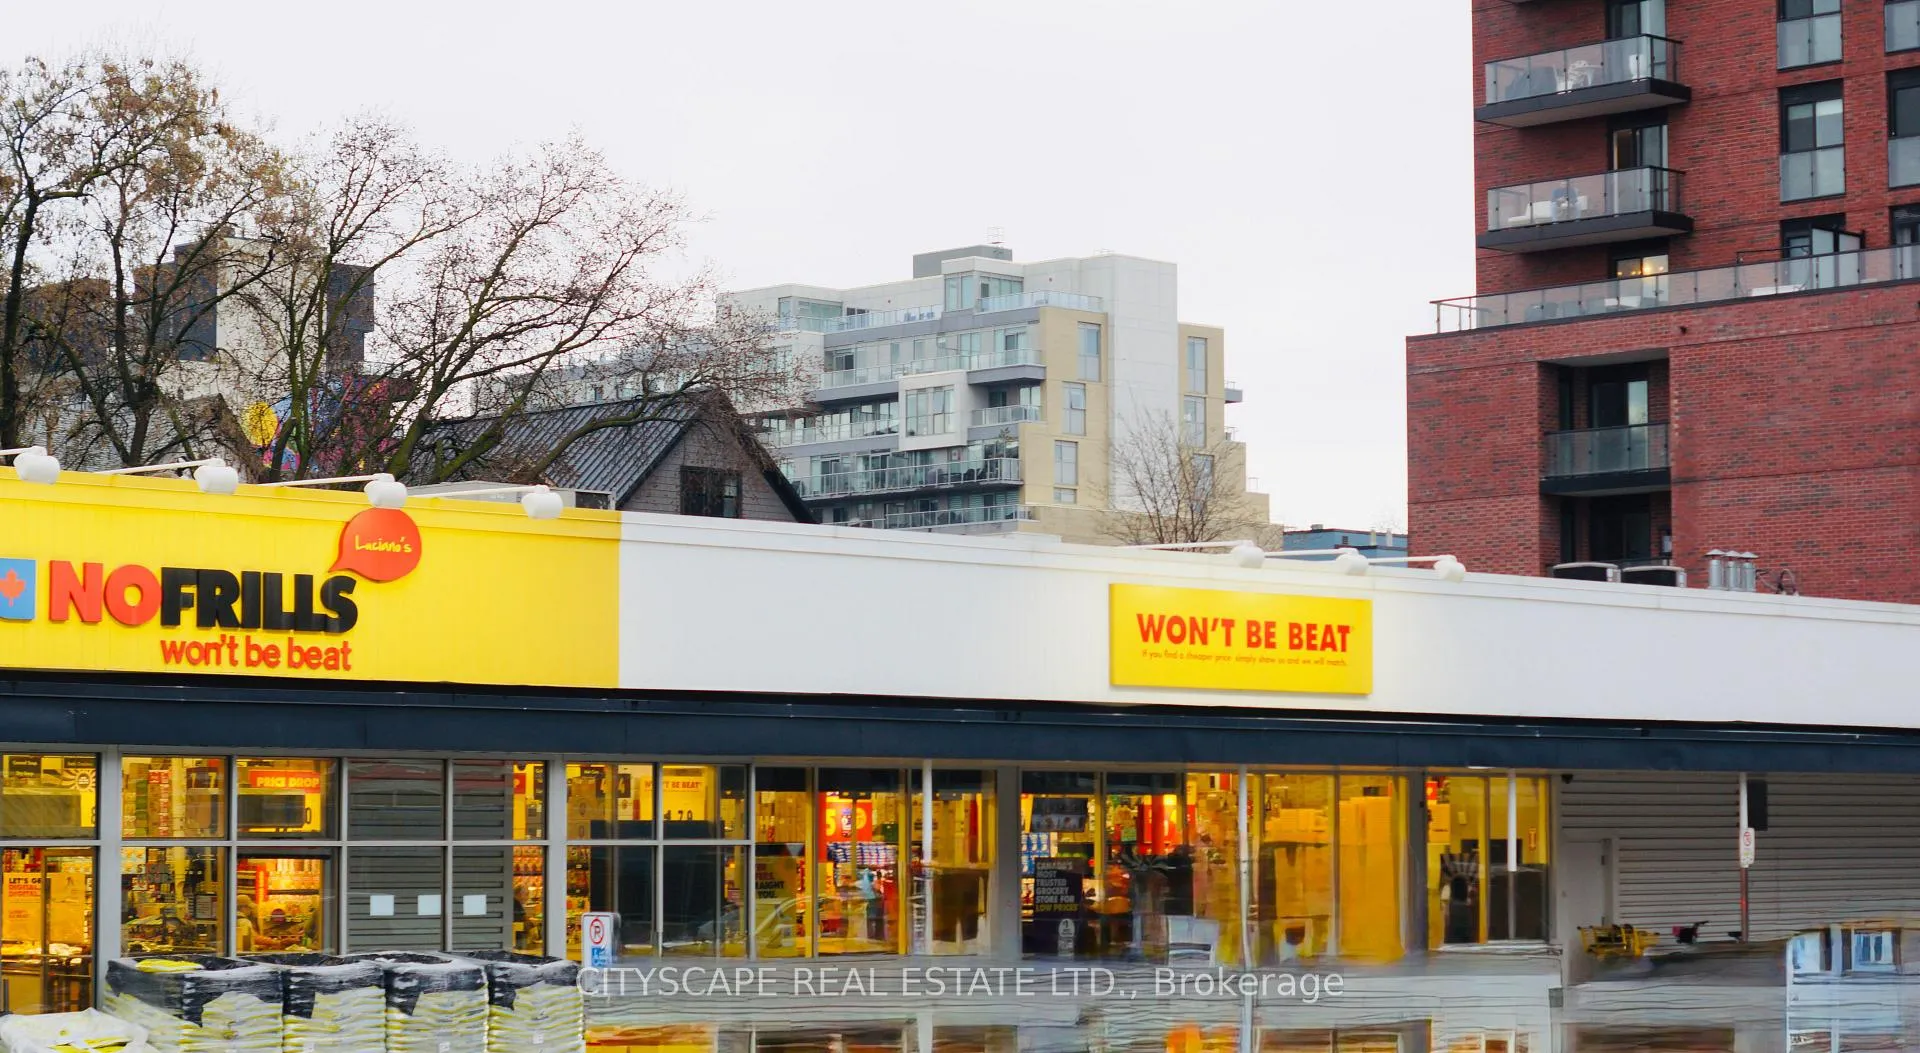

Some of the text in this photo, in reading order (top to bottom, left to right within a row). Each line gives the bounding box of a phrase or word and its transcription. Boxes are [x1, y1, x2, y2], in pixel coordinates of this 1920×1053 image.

[355, 534, 413, 553] Luciano's
[1136, 613, 1351, 652] WON'T BE BEAT
[160, 634, 352, 671] won't be beat
[1150, 652, 1162, 660] you
[288, 777, 320, 788] DROP
